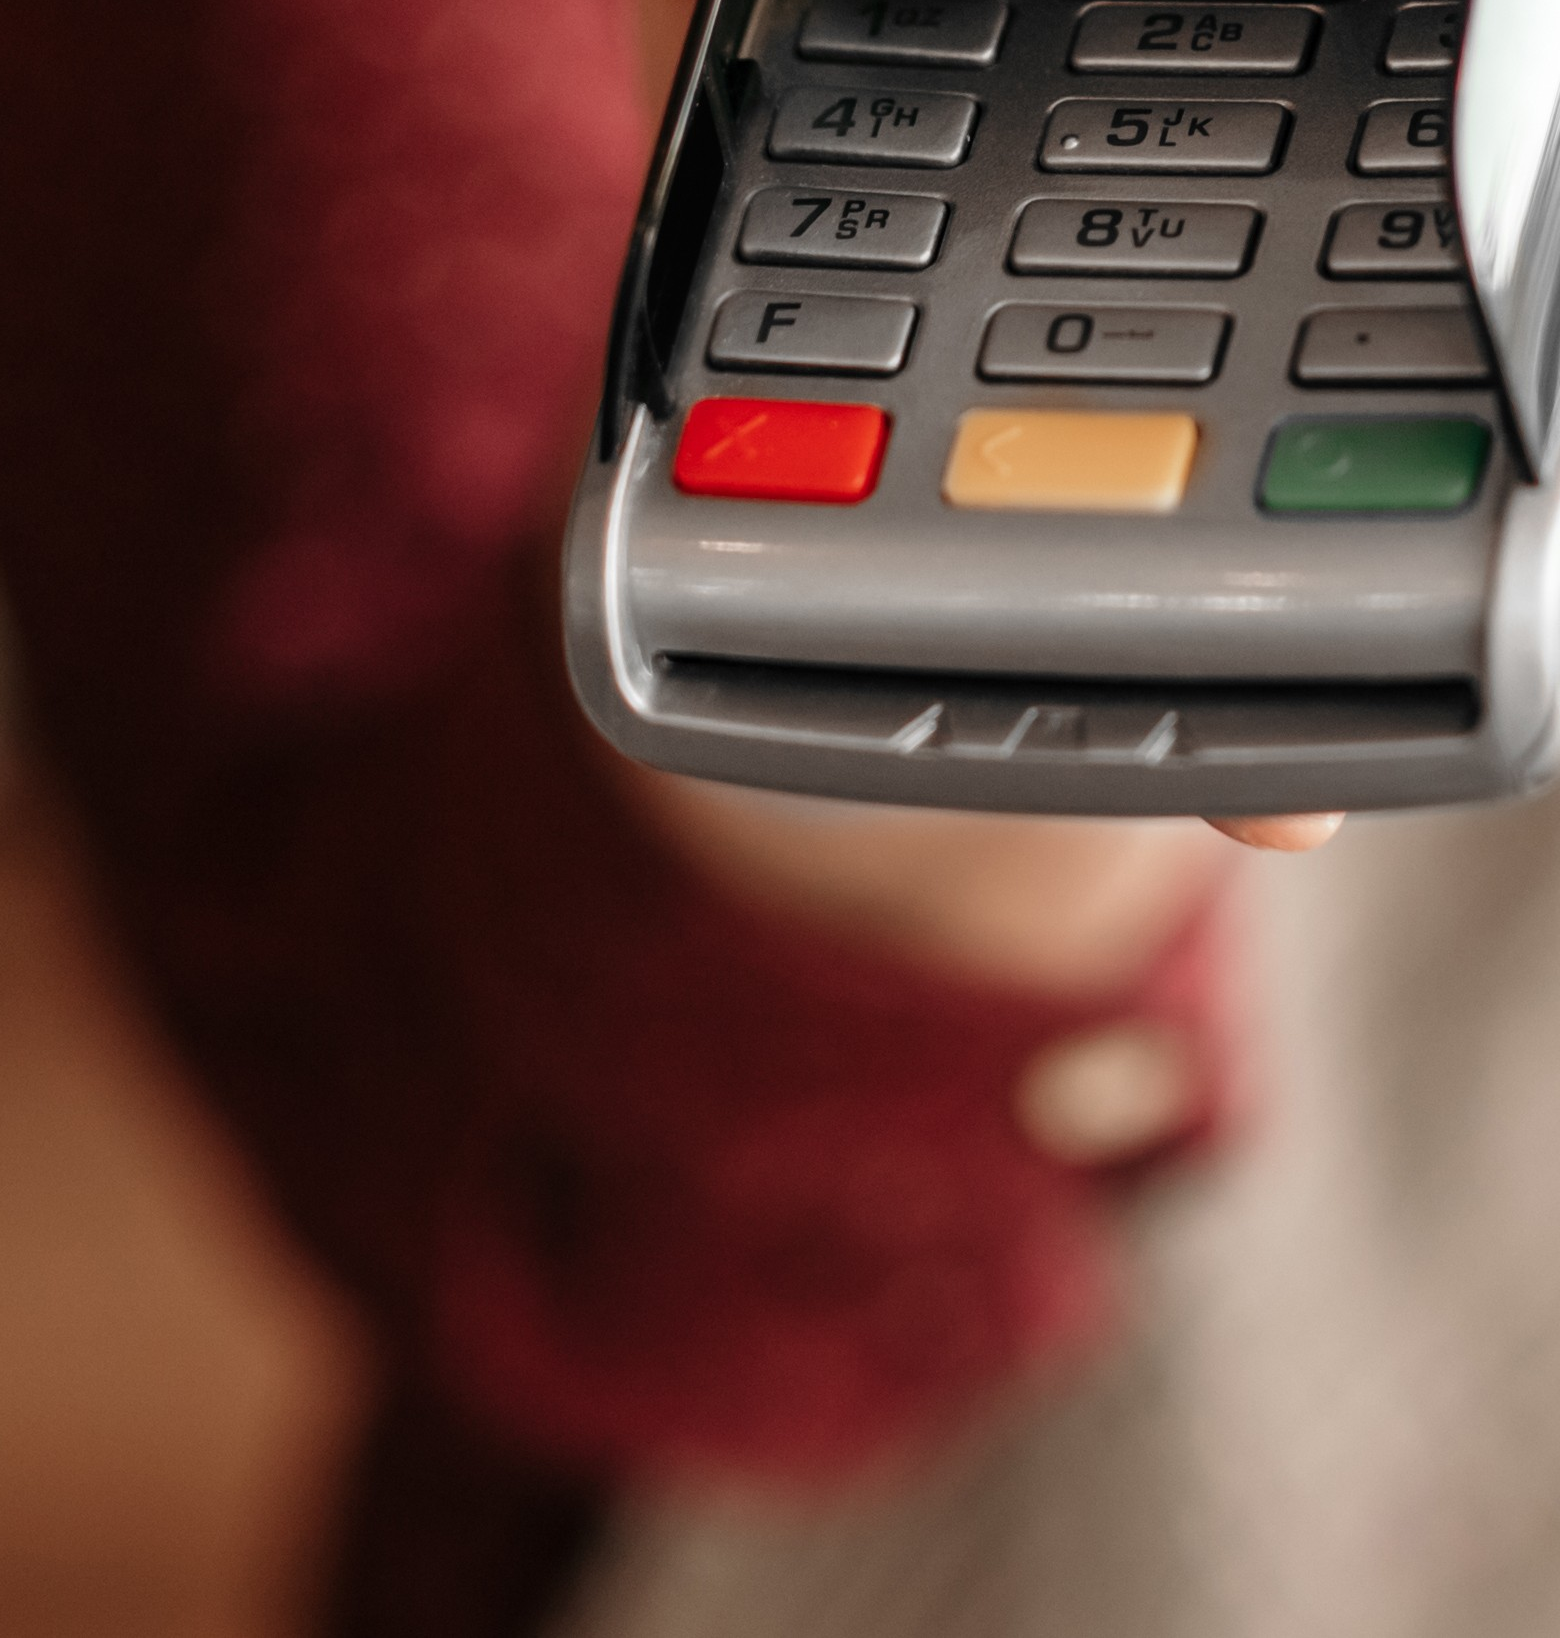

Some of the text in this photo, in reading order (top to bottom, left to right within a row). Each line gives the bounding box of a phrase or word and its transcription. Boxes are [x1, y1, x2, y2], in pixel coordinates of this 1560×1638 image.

[860, 0, 889, 37] 1
[1137, 13, 1184, 51] 2
[811, 97, 858, 138] 4
[1106, 108, 1153, 147] 5
[1407, 108, 1449, 148] 6
[790, 198, 833, 238] 7
[1076, 209, 1124, 248] 8
[1377, 209, 1425, 250] 9
[755, 302, 802, 344] F
[1046, 313, 1095, 354] 0
